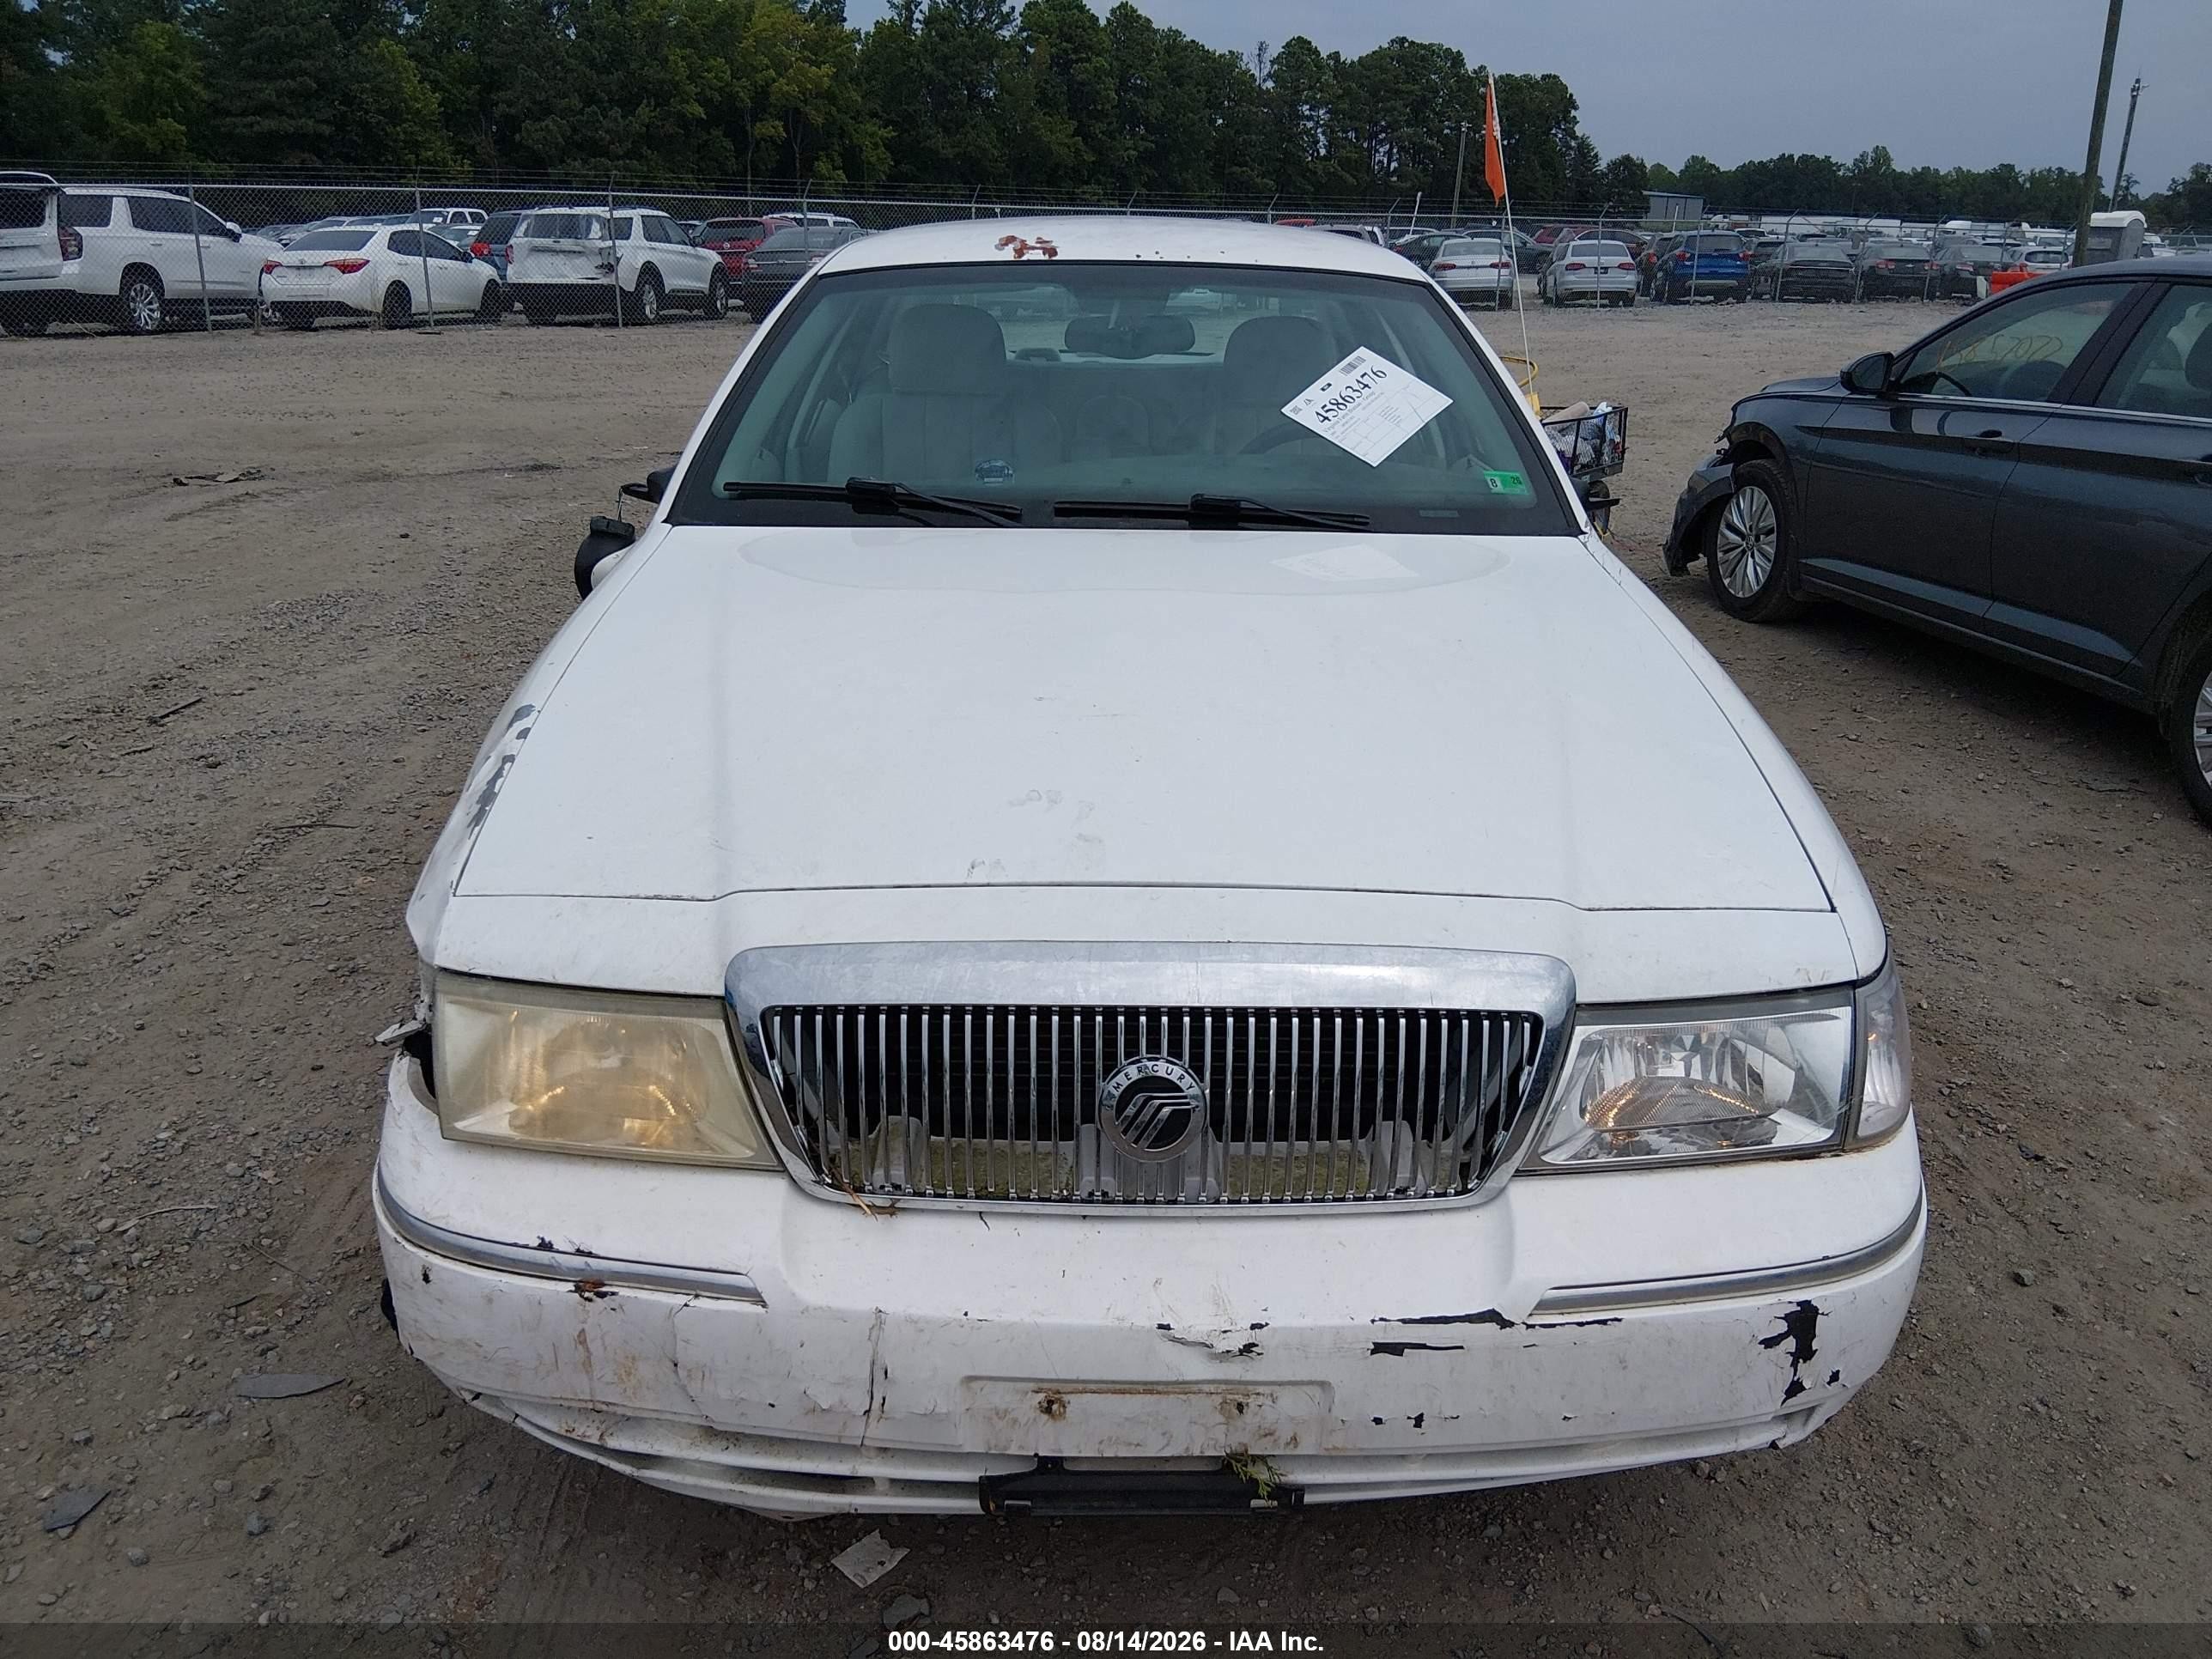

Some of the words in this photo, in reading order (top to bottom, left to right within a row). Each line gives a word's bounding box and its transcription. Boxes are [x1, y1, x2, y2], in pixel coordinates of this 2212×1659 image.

[1316, 365, 1388, 423] 45863476
[1490, 478, 1498, 488] 8
[1112, 1063, 1196, 1093] MERCURY
